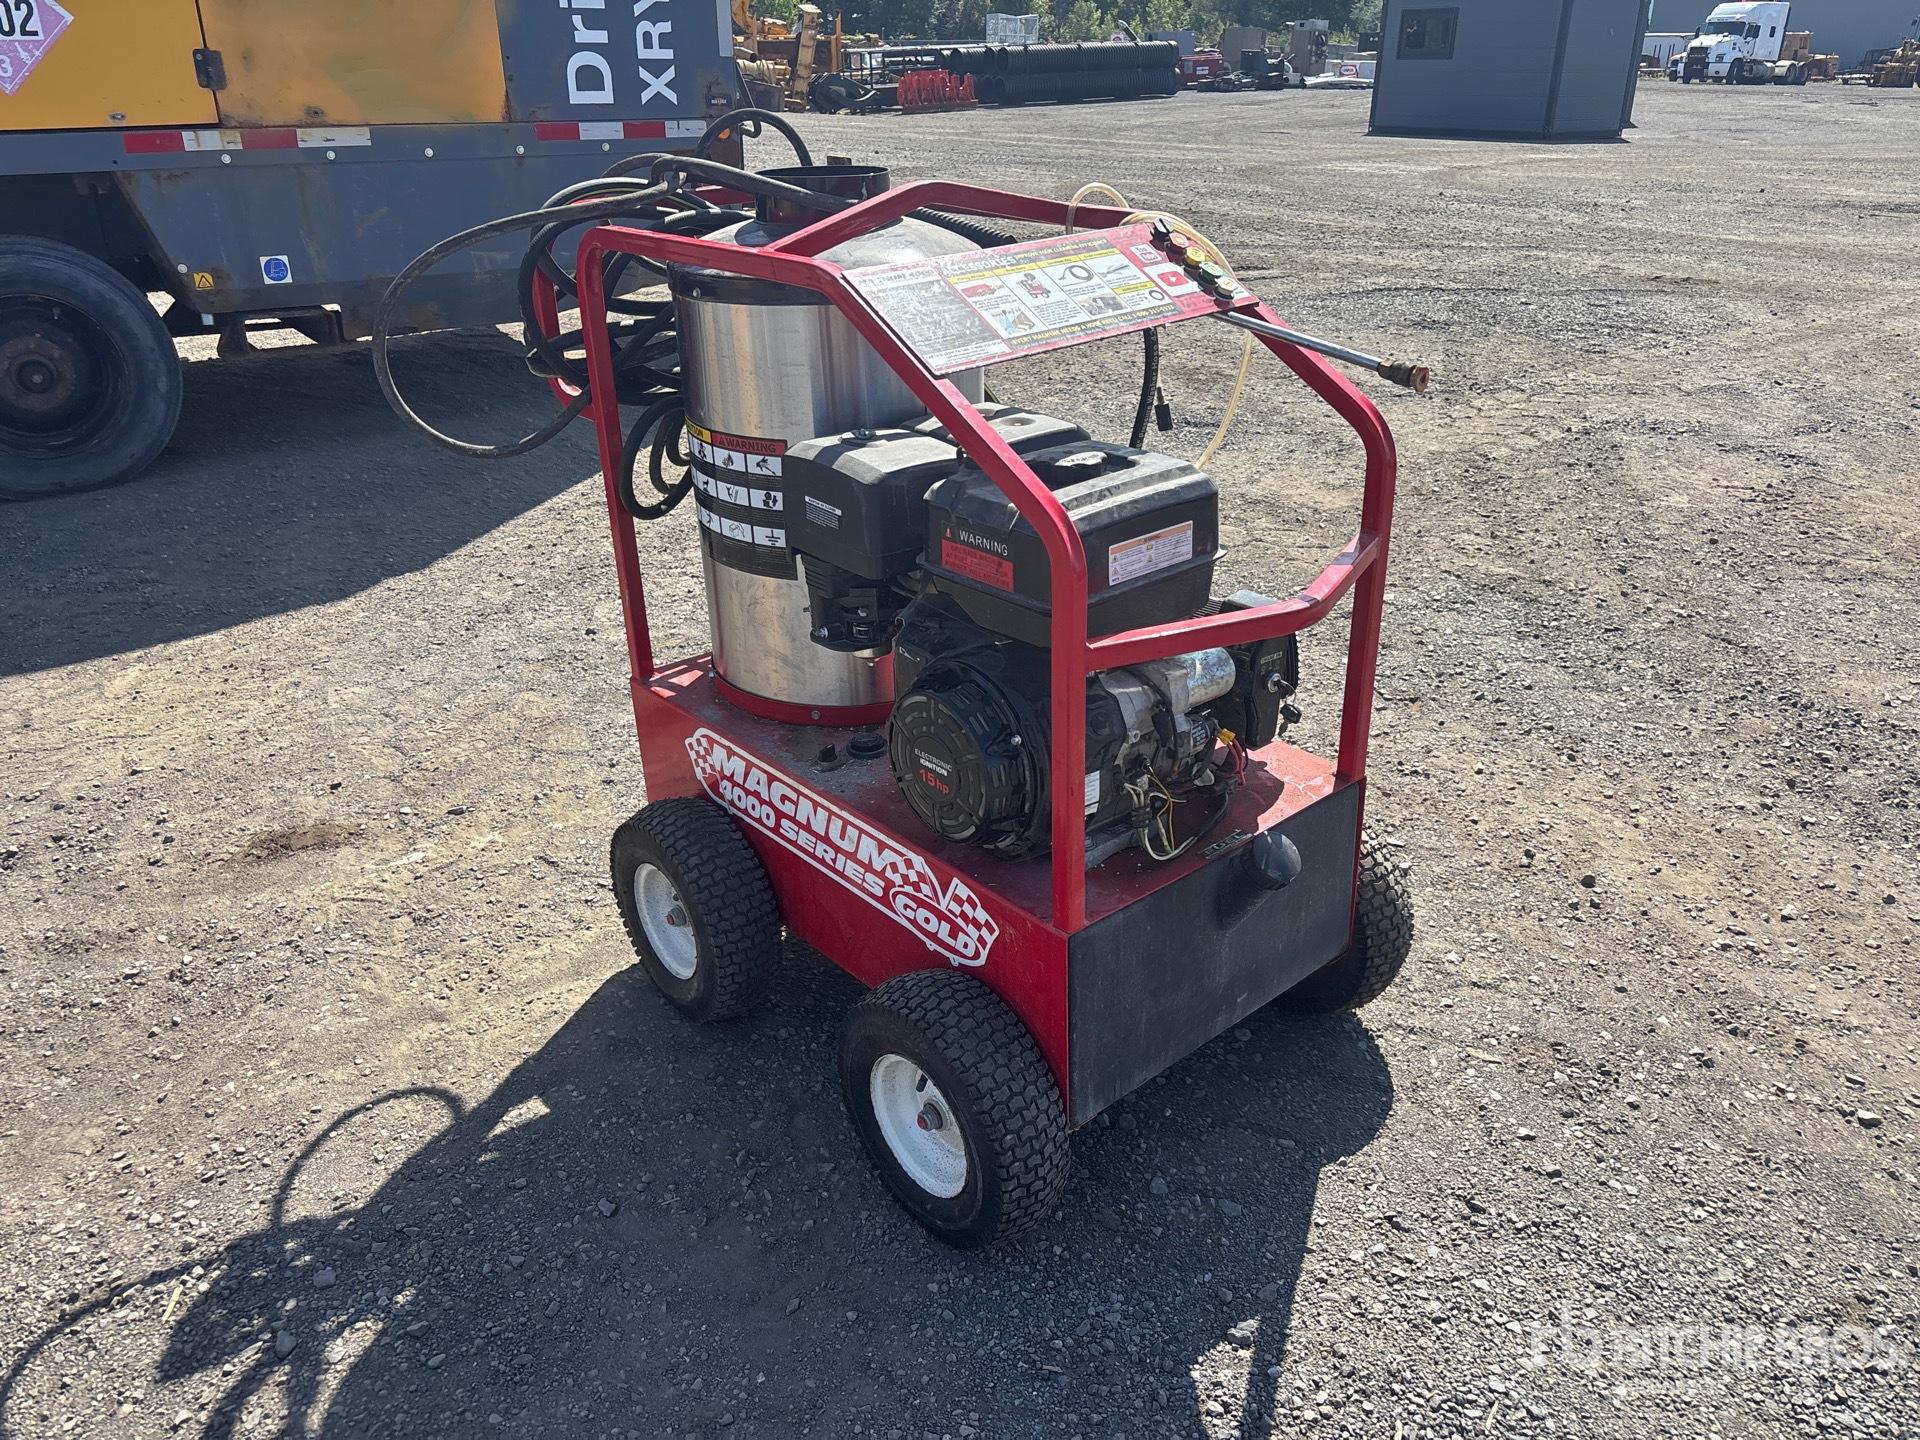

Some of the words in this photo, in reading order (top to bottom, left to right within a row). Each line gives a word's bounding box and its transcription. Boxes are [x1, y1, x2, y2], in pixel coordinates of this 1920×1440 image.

[559, 0, 615, 104] Dri
[1012, 335, 1031, 344] EVERY
[726, 438, 776, 453] WARNING
[959, 530, 1008, 556] WARNING
[914, 748, 952, 772] ELECTRONIC
[919, 758, 948, 777] IGNITION
[919, 768, 949, 795] 15hp
[711, 743, 898, 875] MAGNUM
[719, 779, 776, 829] 4000
[779, 819, 885, 898] SERIES
[894, 894, 976, 958] GOLD
